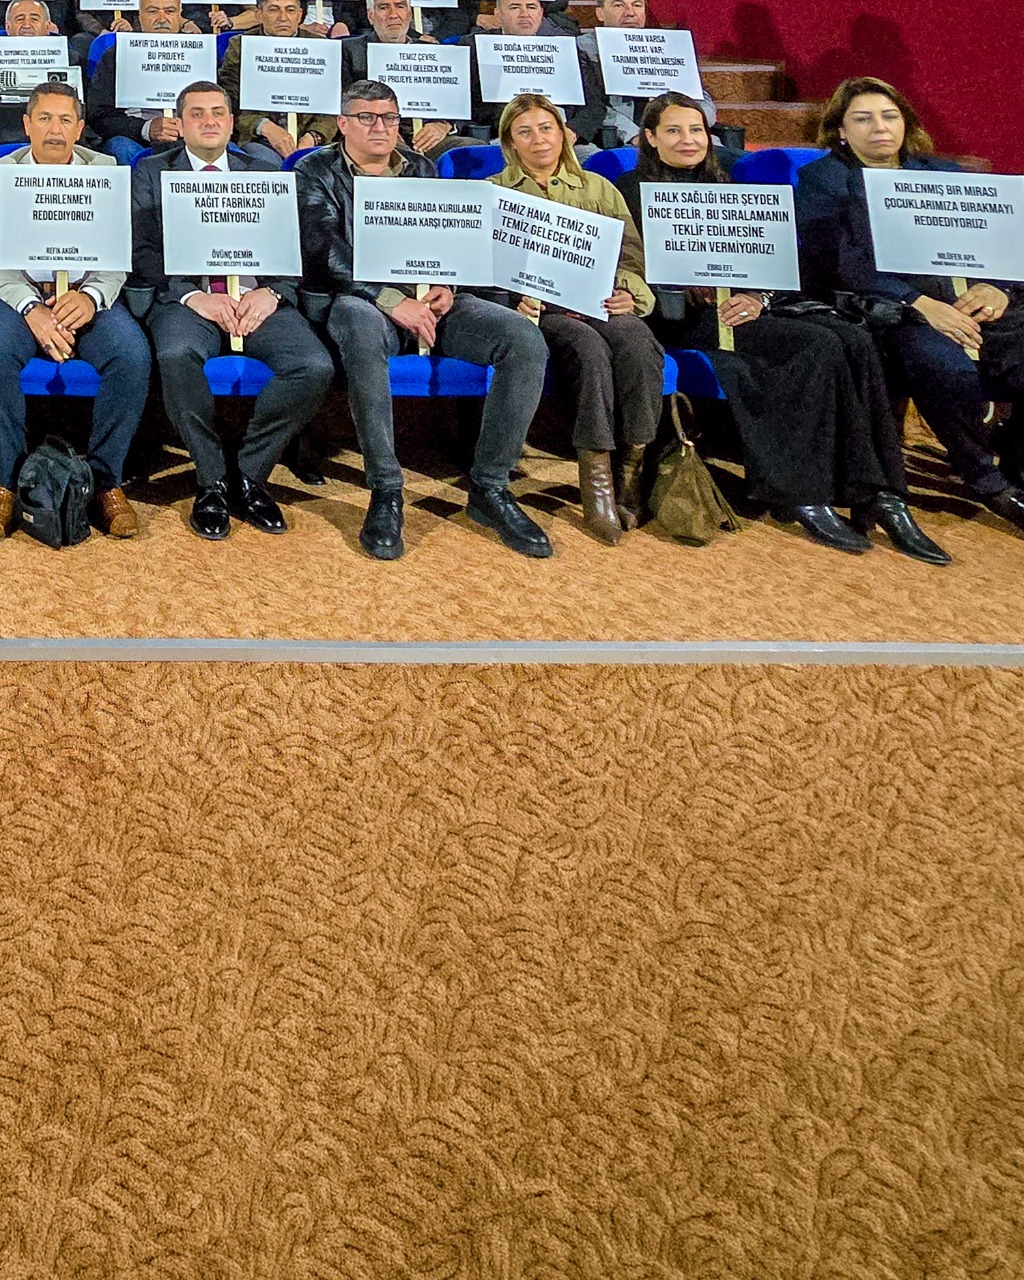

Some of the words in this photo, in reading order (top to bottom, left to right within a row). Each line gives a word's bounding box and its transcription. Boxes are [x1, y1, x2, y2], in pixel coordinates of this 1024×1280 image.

[14, 176, 44, 187] ZEHIRLI
[46, 177, 84, 188] ATIKLARA
[170, 182, 228, 193] TORBALIMIZIN
[230, 180, 270, 194] GELECEĞİ
[271, 181, 289, 196] İÇİN
[894, 182, 944, 196] KIRLENMIŞ
[945, 184, 962, 195] BIR
[963, 186, 997, 197] MIRASI
[35, 193, 91, 204] ZEHIRLENMEYI
[194, 195, 219, 208] KAĞIT
[221, 196, 265, 208] FABRİKASI
[654, 191, 679, 202] HALK
[681, 190, 717, 204] SAĞLIĞI
[719, 193, 739, 204] HER
[741, 193, 779, 206] ŞEYDEN
[884, 197, 958, 211] ÇOCUKLARIMIZA
[960, 201, 1014, 214] BIRAKMAYI
[364, 200, 374, 210] BU
[375, 201, 406, 211] FABRIKA
[407, 202, 436, 212] BURADA
[438, 203, 482, 214] KURULAMAZ
[647, 205, 672, 219] ÖNCE
[674, 206, 703, 220] GELİR,
[706, 208, 719, 220] BU
[721, 209, 789, 222] SIRALAMANIN
[32, 210, 94, 221] REDDEDIYORUZ!
[201, 210, 260, 223] İSTEMİYORUZ!
[364, 215, 417, 226] DAYATMALARA
[418, 217, 440, 229] KARŞI
[441, 218, 482, 229] ÇIKIYORUZ!
[498, 198, 526, 216] TEMİZ
[526, 207, 552, 225] HAVA,
[556, 215, 584, 233] TEMİZ
[585, 224, 600, 239] SU,
[914, 215, 987, 229] REDDEDIYORUZ!
[501, 215, 529, 233] TEMİZ
[530, 224, 571, 245] GELECEK
[572, 235, 592, 251] İÇİN
[672, 222, 704, 236] TEKLİF
[706, 224, 764, 238] EDİLMESİNE
[211, 248, 232, 260] ÖVÜNÇ
[233, 249, 253, 258] DEMİR
[492, 228, 508, 243] BİZ
[508, 234, 522, 247] DE
[522, 238, 550, 255] HAYIR
[551, 247, 595, 269] DİYORUZ!
[664, 238, 686, 251] BİLE
[687, 238, 706, 252] İZİN
[708, 240, 774, 255] VERMİYORUZ!
